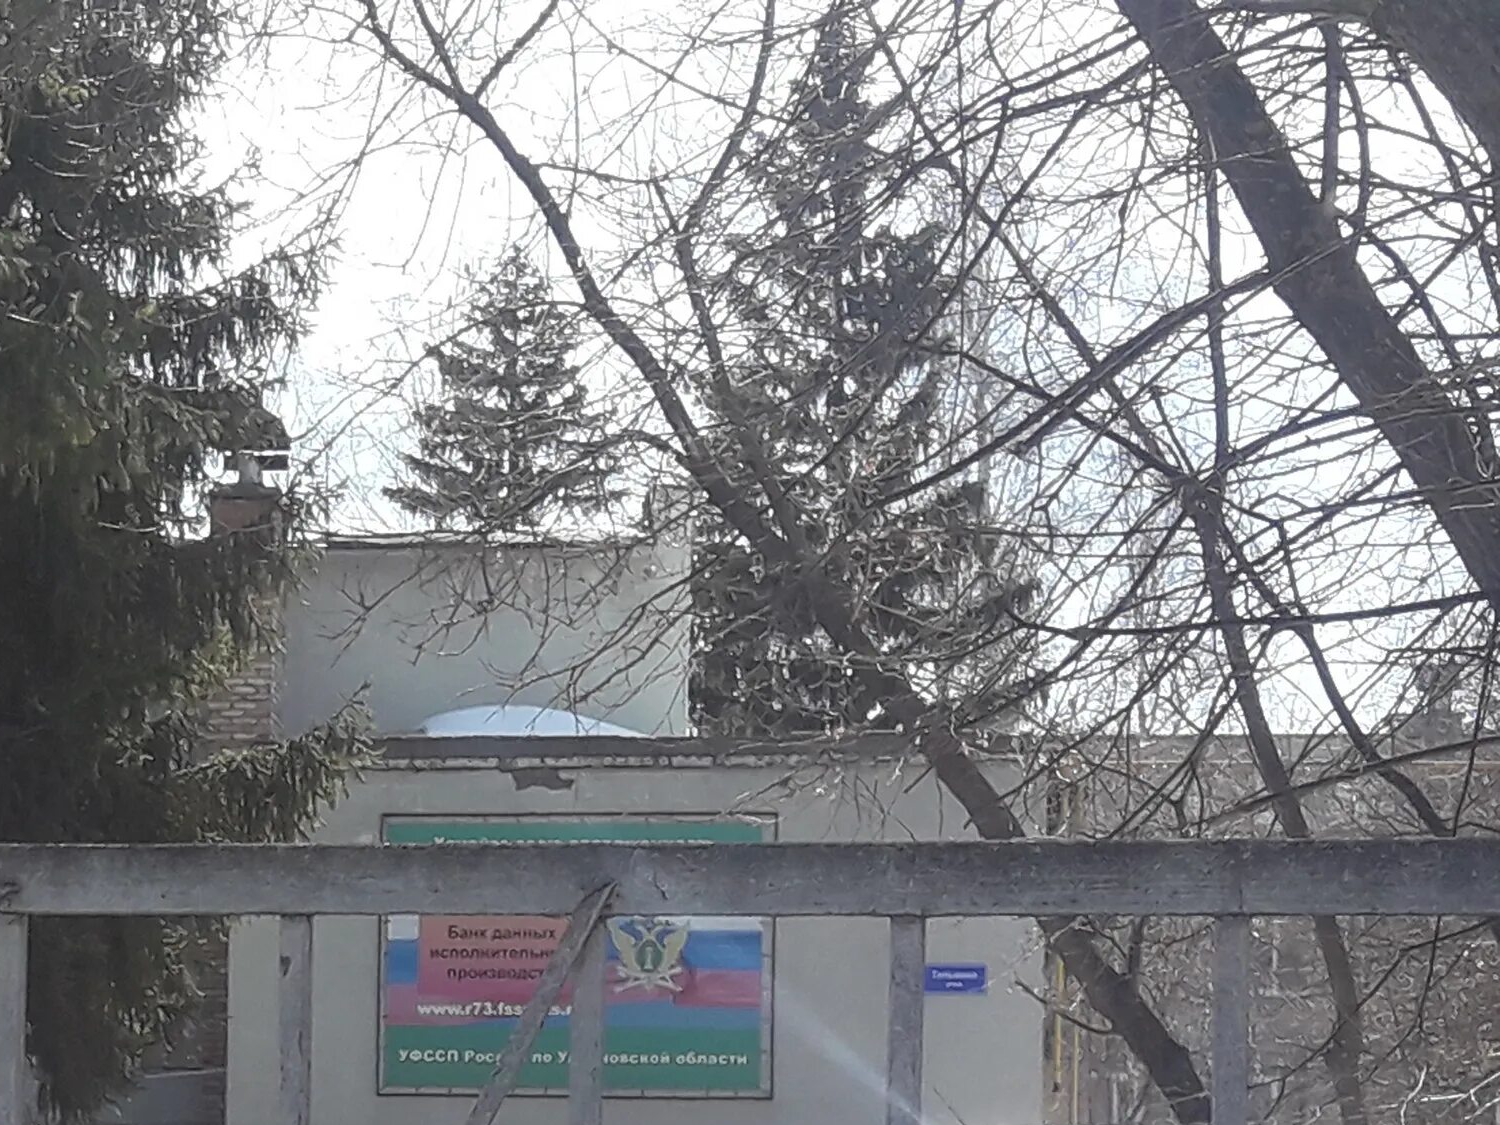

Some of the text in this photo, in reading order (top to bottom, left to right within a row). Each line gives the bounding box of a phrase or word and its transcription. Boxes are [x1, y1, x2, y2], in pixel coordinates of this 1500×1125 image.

[448, 924, 557, 941] Банк данных
[429, 947, 555, 960] исполнительн
[398, 1048, 460, 1063] УФССП
[531, 1052, 553, 1065] по
[674, 1051, 749, 1066] области
